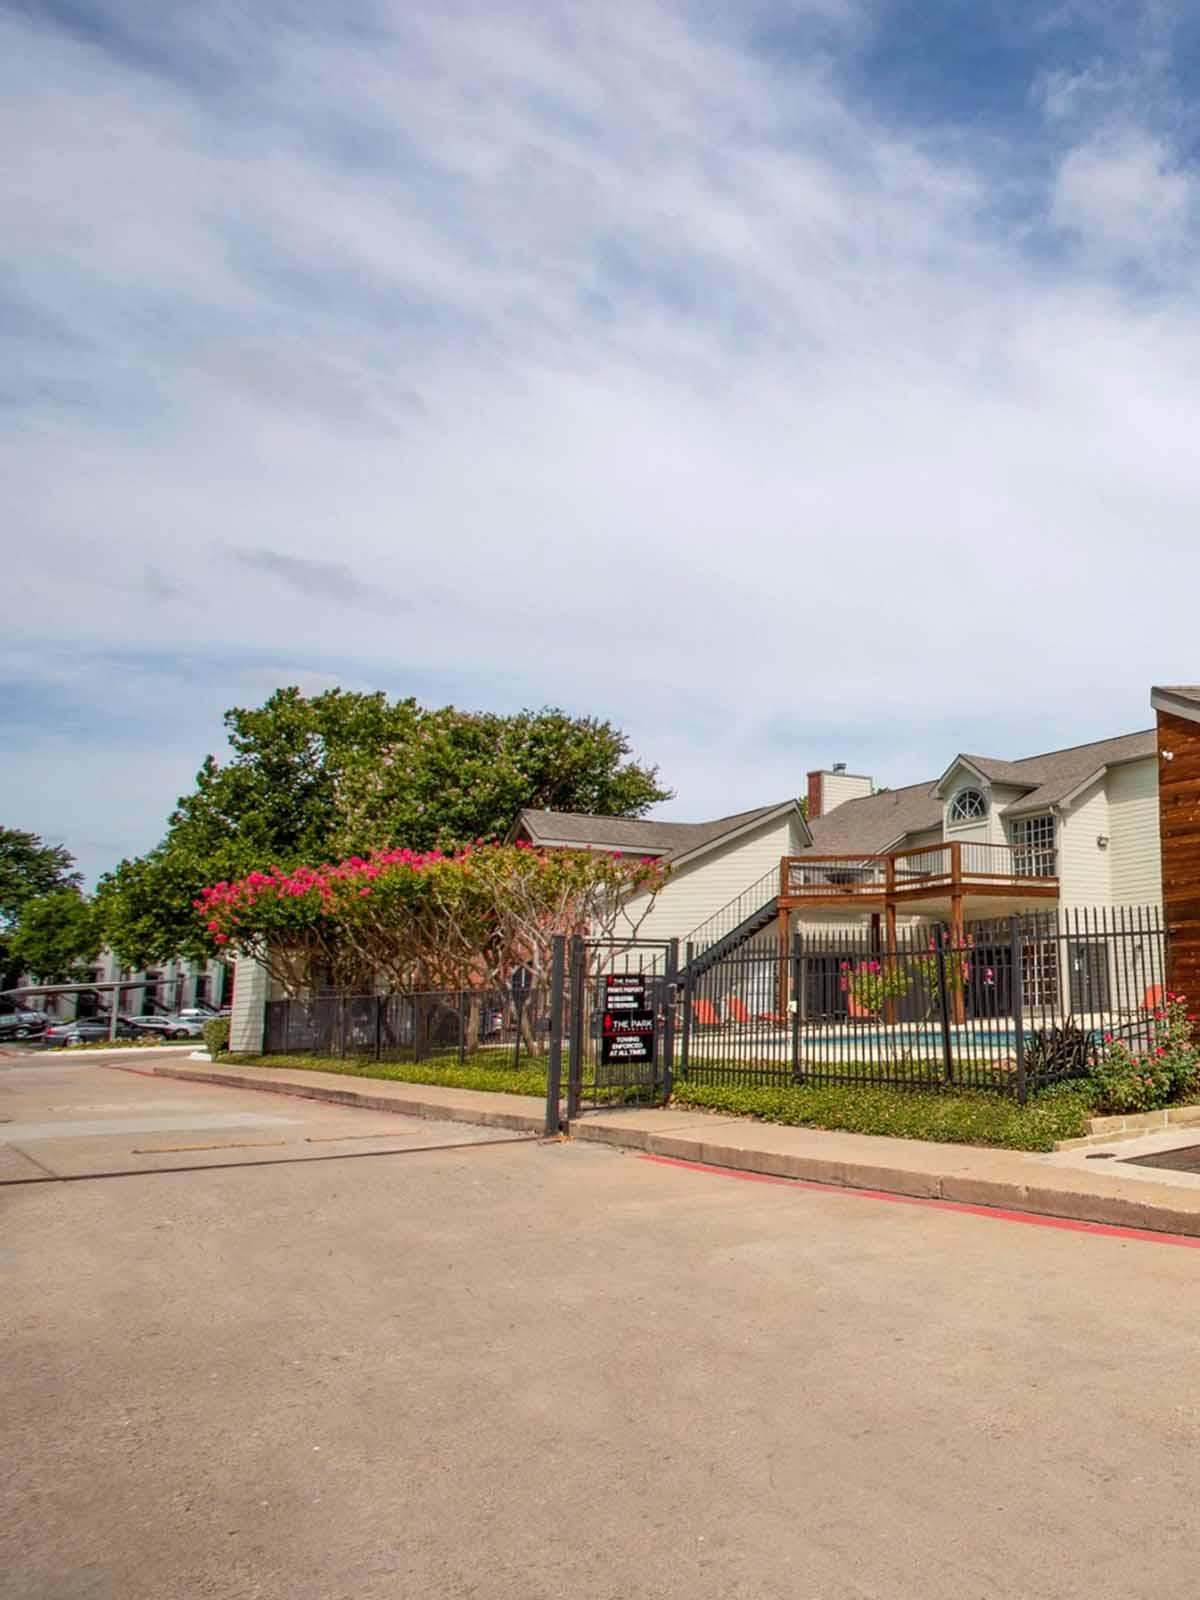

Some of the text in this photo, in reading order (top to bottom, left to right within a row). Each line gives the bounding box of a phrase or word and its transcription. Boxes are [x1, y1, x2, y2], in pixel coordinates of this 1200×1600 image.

[613, 1019, 653, 1028] THE PARK
[612, 1042, 644, 1050] ENFORCED
[629, 1048, 647, 1056] TIMES
